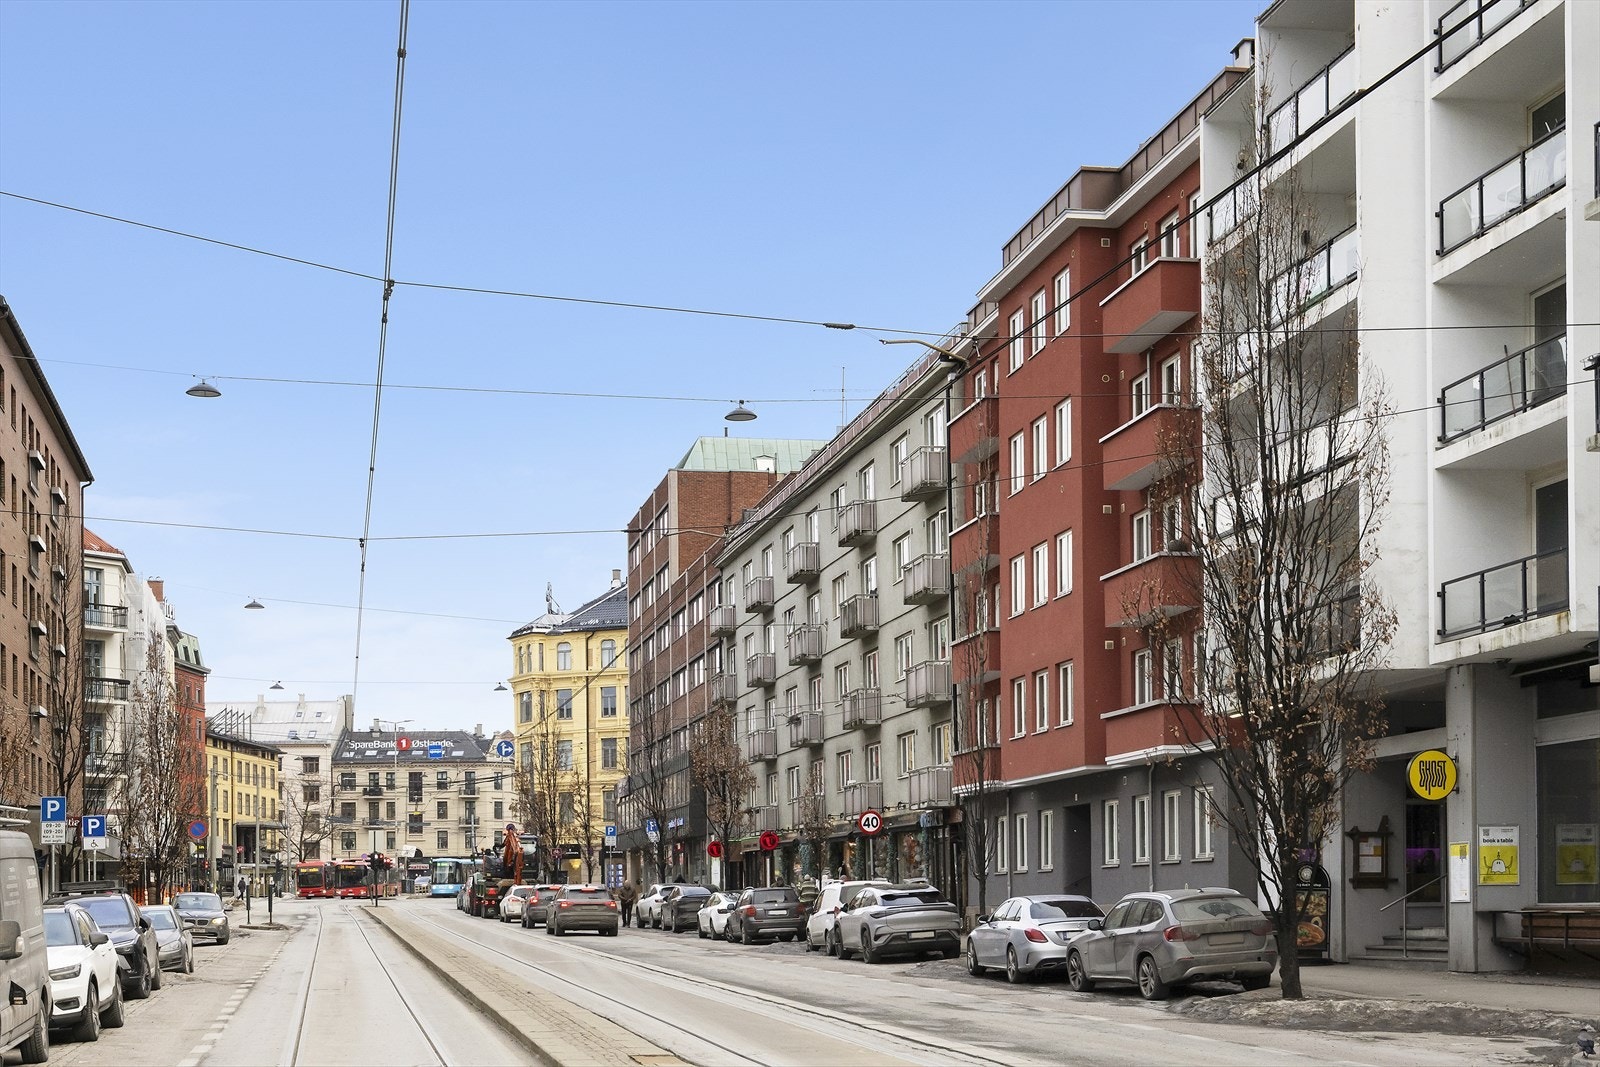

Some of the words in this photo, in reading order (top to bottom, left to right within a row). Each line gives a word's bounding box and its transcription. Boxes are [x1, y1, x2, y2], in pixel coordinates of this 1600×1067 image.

[349, 740, 396, 750] SpareBank
[1419, 760, 1447, 796] GHOST
[46, 799, 60, 819] P
[87, 818, 100, 835] P
[862, 816, 879, 829] 40
[607, 826, 614, 836] P
